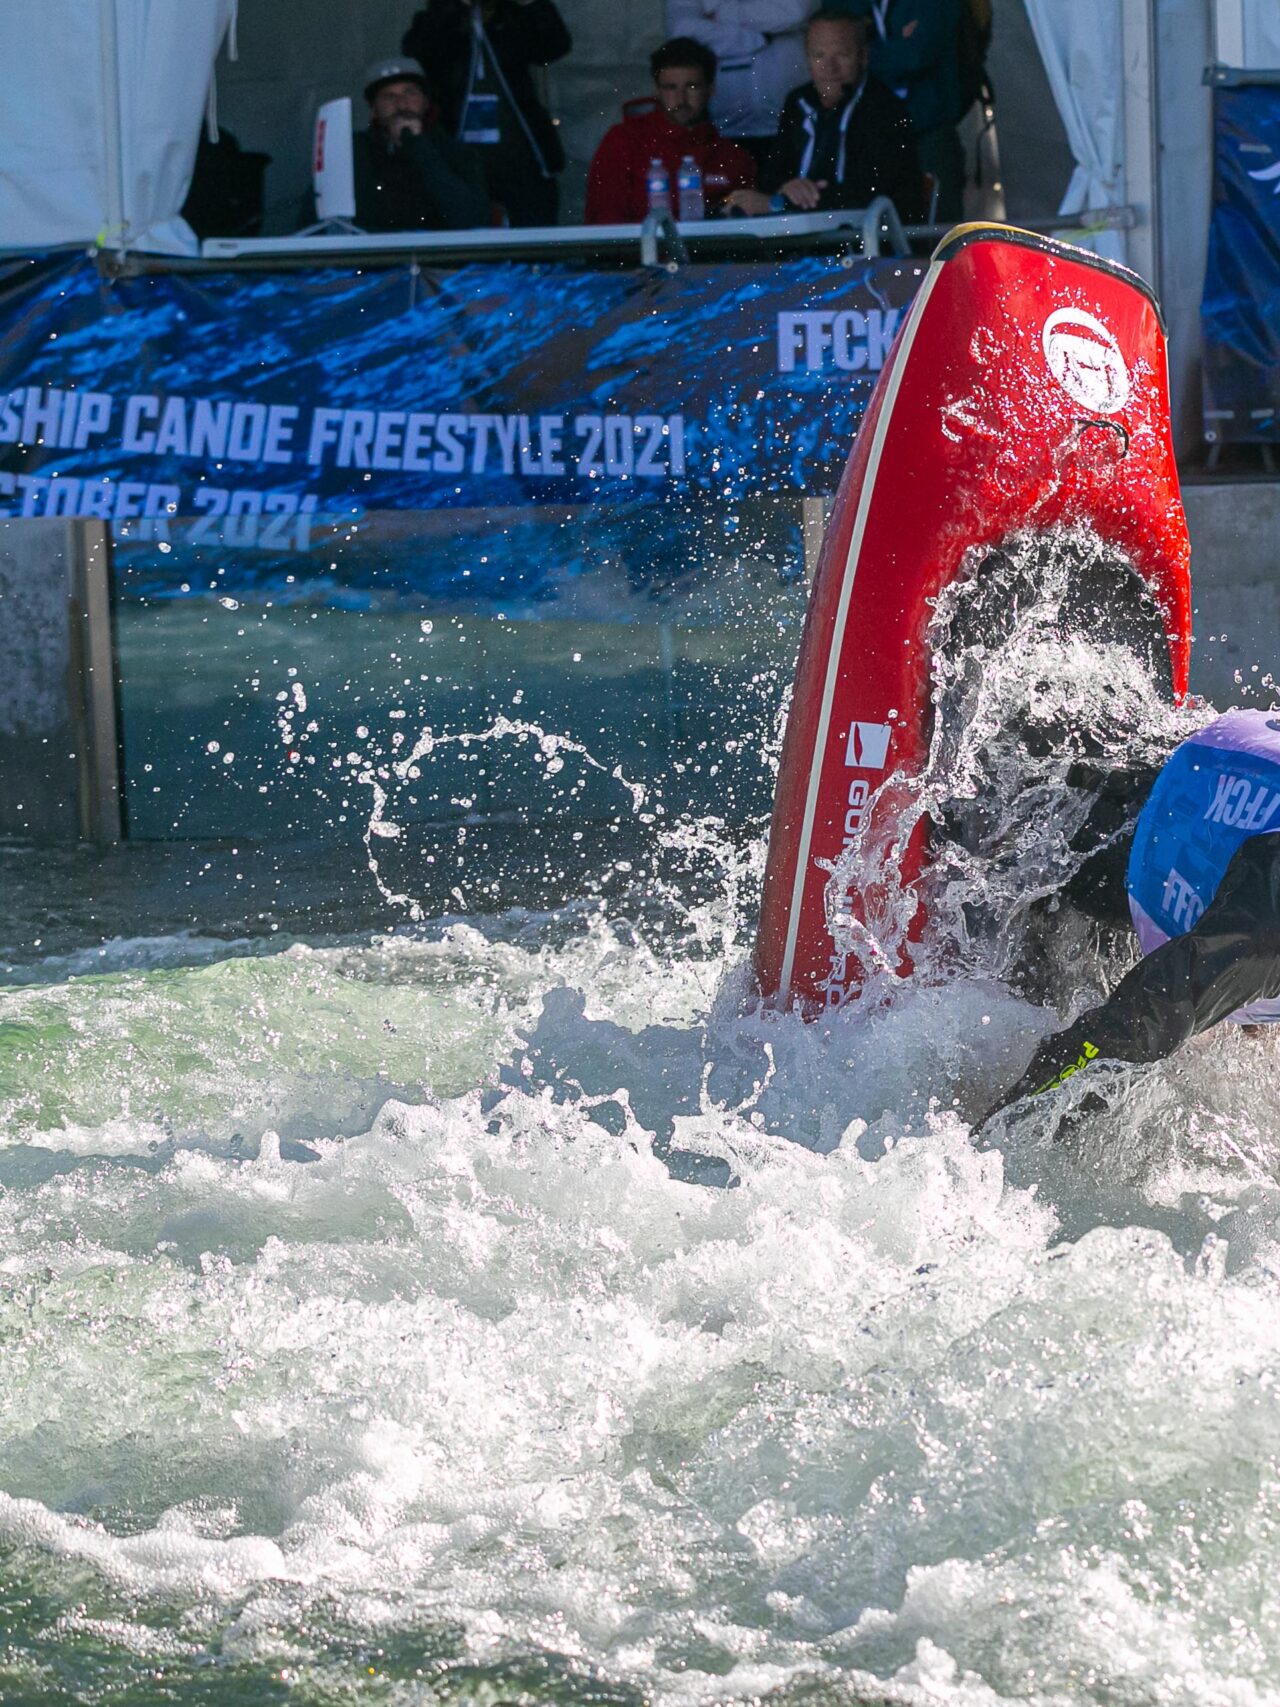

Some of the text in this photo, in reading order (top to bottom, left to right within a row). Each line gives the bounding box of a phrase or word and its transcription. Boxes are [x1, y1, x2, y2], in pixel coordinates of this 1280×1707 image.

[777, 309, 900, 373] FFCK
[122, 393, 299, 464] CANOE
[307, 407, 566, 476] FREESTYLE
[574, 413, 687, 477] 2021
[187, 486, 318, 551] 2021
